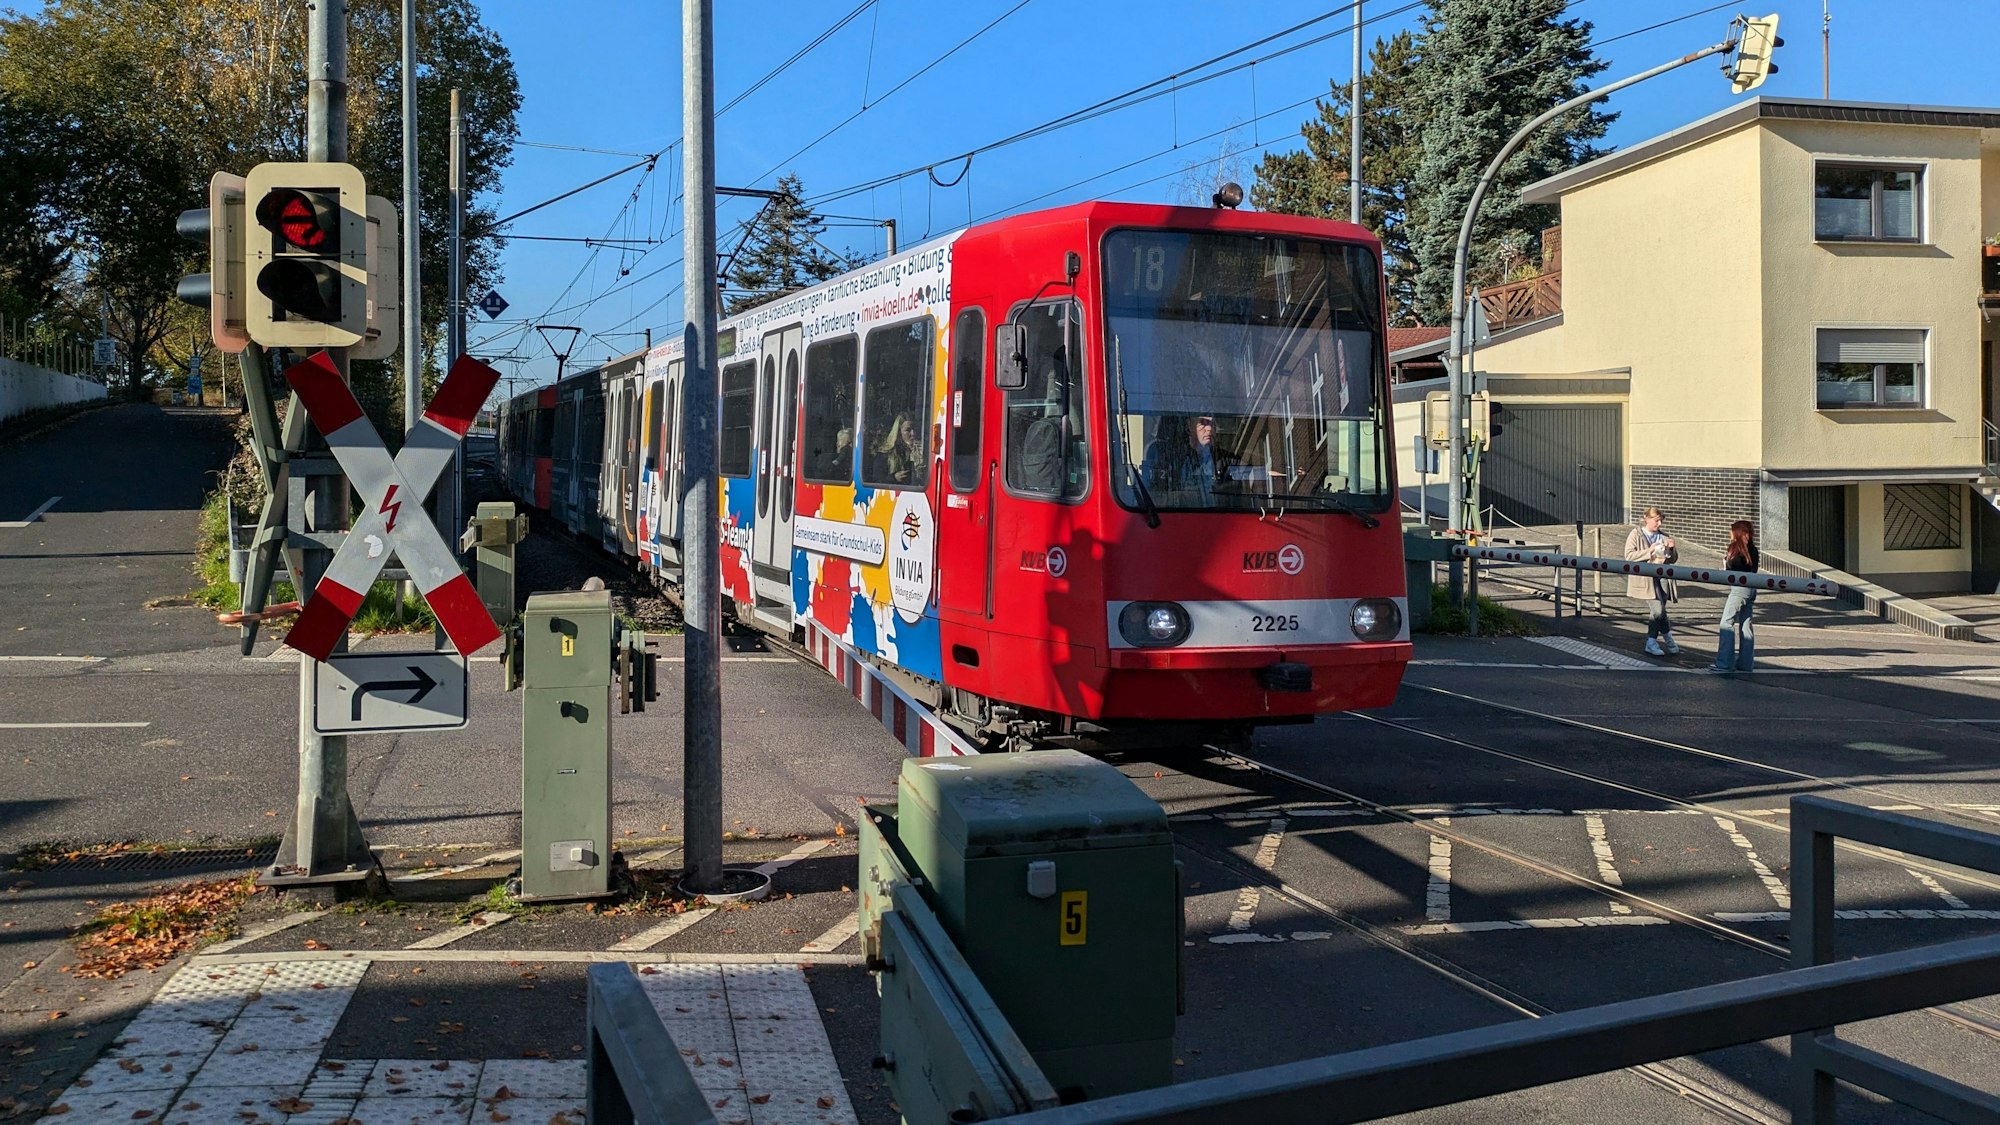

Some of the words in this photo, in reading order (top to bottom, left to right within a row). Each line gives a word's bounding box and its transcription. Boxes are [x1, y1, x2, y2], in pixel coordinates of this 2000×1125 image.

[1131, 246, 1165, 291] 18
[756, 311, 768, 331] gute
[769, 292, 823, 320] Arbeitsbedingungen
[827, 277, 858, 303] tarifliche
[860, 264, 901, 292] Bezahlung
[908, 248, 944, 276] Bildung
[814, 317, 820, 336] &
[821, 311, 856, 334] Förderung
[861, 287, 919, 323] invia-koeln.de
[795, 524, 820, 542] Gemeinsam
[820, 530, 831, 544] stark
[831, 530, 839, 546] für
[840, 532, 882, 555] Grundschul-Kids
[895, 556, 906, 580] IN
[907, 559, 924, 584] VIA
[1020, 550, 1047, 568] KVB
[1243, 552, 1278, 569] KVB
[1252, 615, 1299, 632] 2225
[564, 639, 570, 652] 1
[1066, 900, 1082, 935] 5
